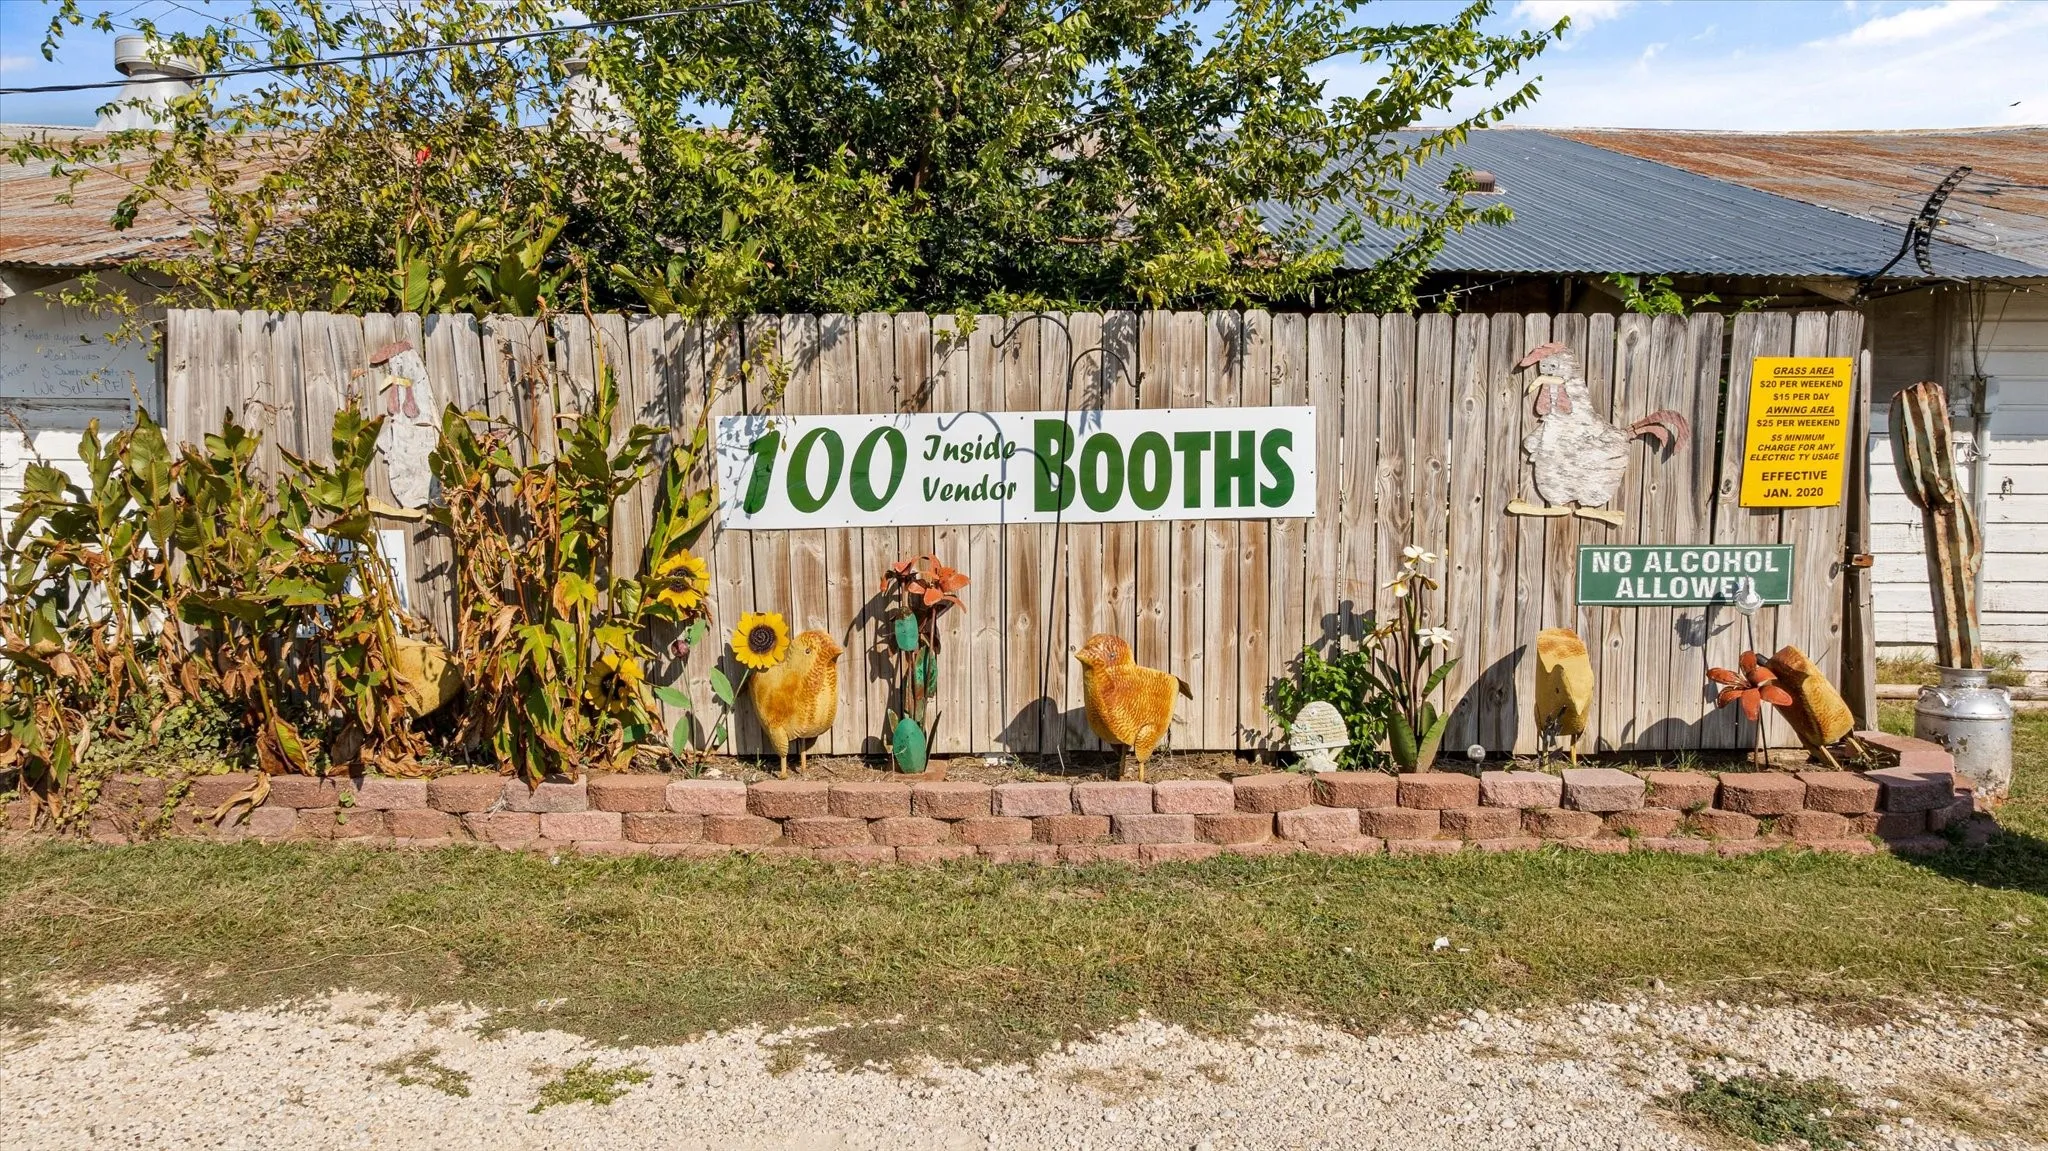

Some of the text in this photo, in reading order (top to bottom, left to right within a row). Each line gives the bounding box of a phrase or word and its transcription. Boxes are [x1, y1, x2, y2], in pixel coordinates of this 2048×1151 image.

[1773, 367, 1834, 375] GRASS AREA
[33, 382, 56, 396] We
[62, 379, 86, 397] Sell
[1760, 380, 1844, 388] $20 PER WEEKEND
[1773, 393, 1830, 401] $15 PER DAY
[1766, 406, 1835, 414] AWNING AREA
[1756, 419, 1840, 427] $25 PER WEEKEND
[1817, 443, 1836, 451] ANY
[742, 419, 1296, 514] 100 Inside Vendor BOOTHS
[1761, 470, 1828, 481] EFFECTIVE
[1763, 487, 1824, 498] JAN. 2020
[1592, 551, 1779, 573] NO ALCOHOL
